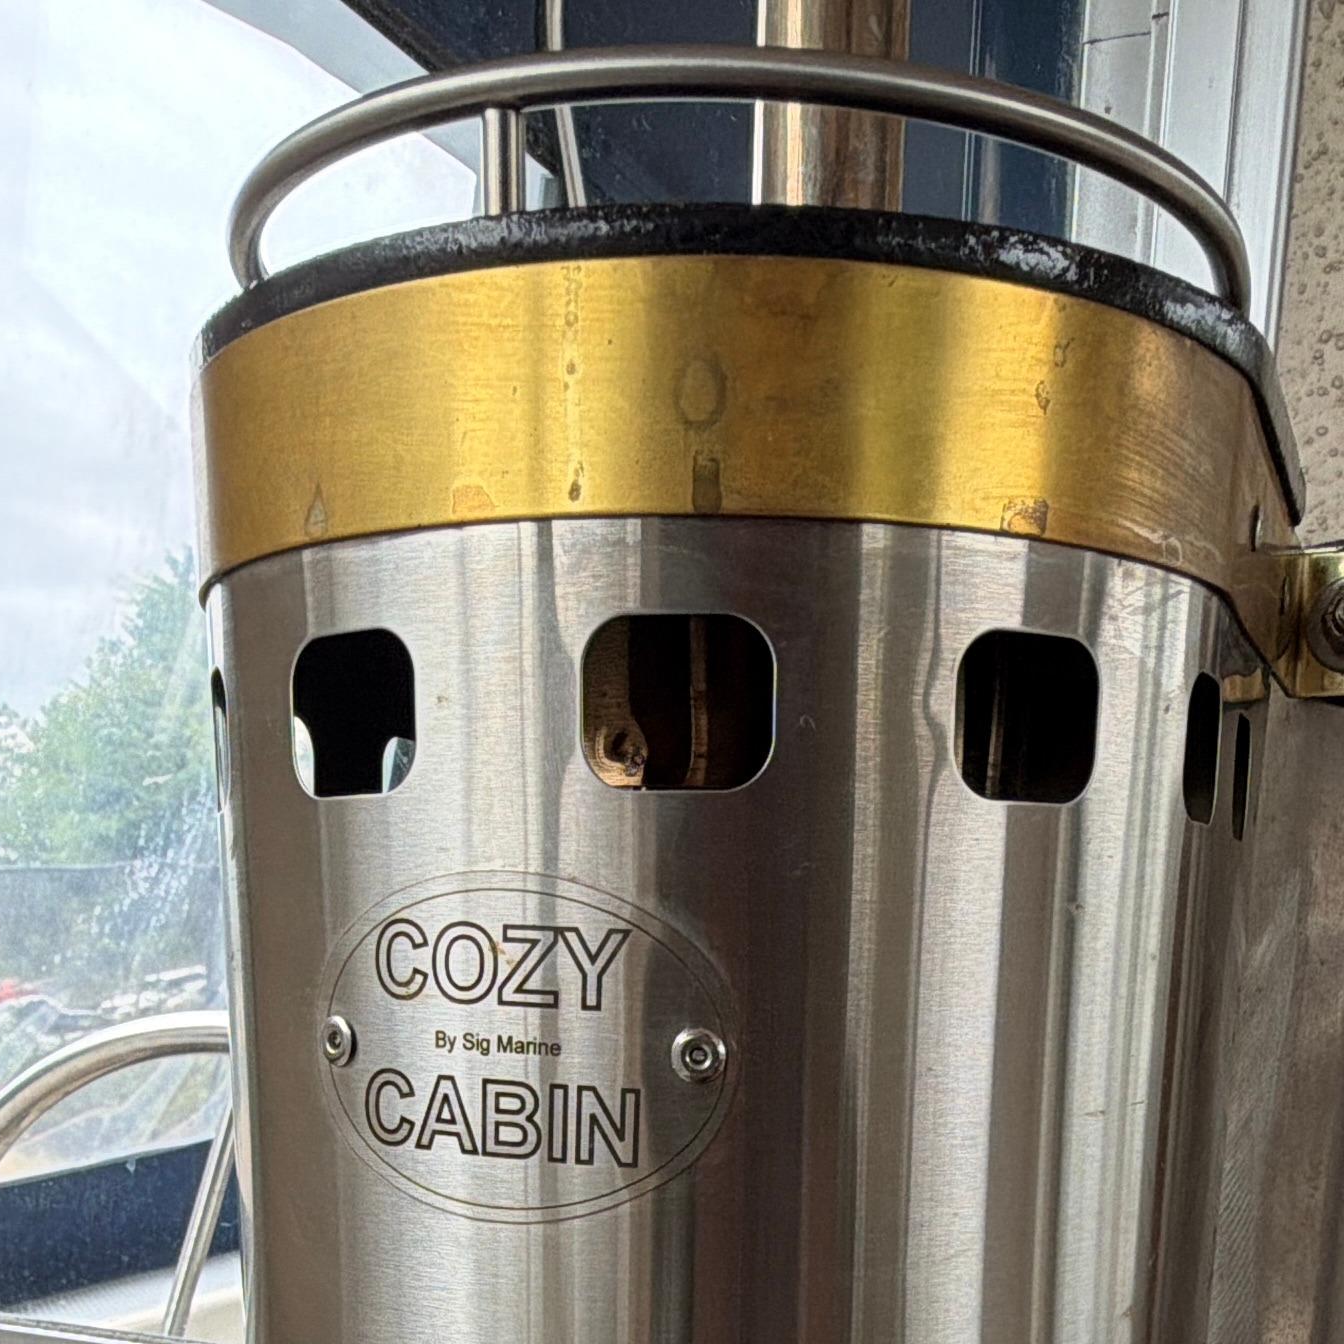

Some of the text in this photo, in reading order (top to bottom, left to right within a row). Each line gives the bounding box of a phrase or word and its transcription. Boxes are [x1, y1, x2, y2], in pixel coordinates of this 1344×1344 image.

[374, 917, 632, 1012] COZY
[435, 1029, 562, 1057] By Sig Marine
[364, 1067, 642, 1168] CABIN
